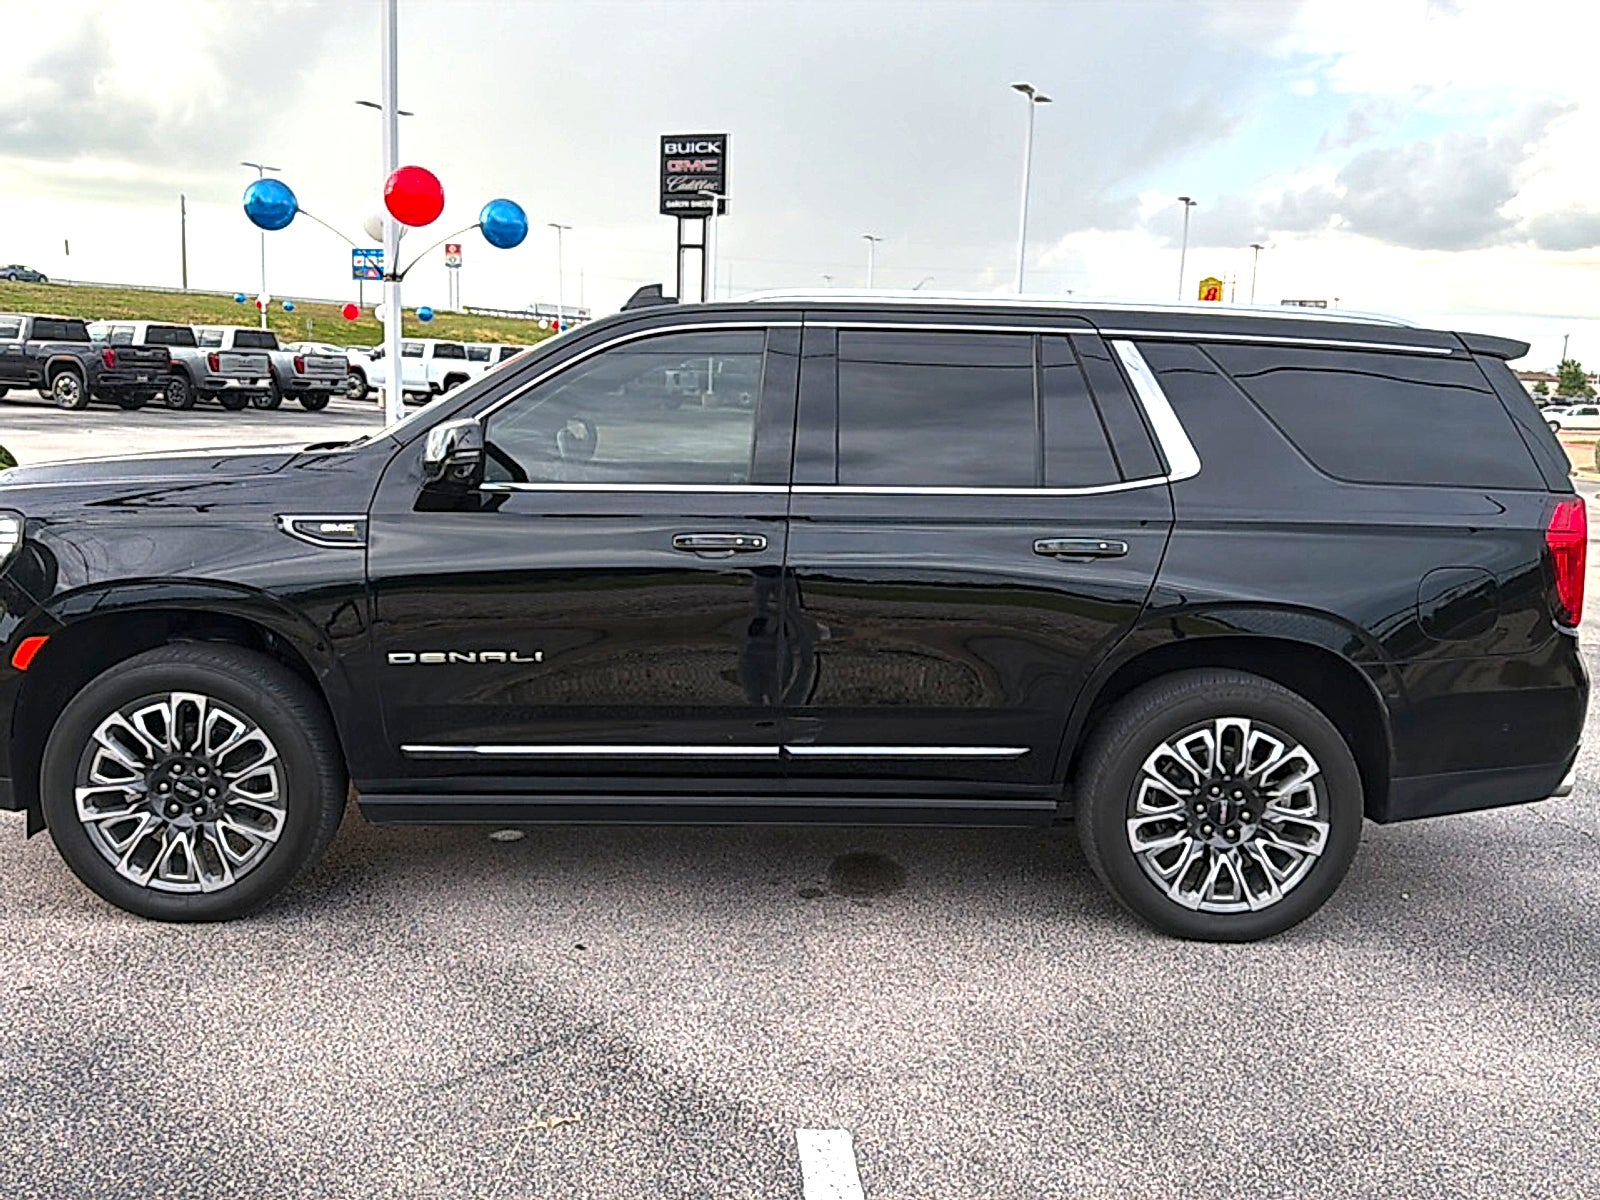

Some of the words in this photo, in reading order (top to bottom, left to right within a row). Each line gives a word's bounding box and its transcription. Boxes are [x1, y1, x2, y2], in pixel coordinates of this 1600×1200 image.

[664, 142, 721, 154] BUICK
[666, 159, 718, 172] GMC
[320, 523, 355, 532] GMC
[388, 651, 543, 664] DENALI
